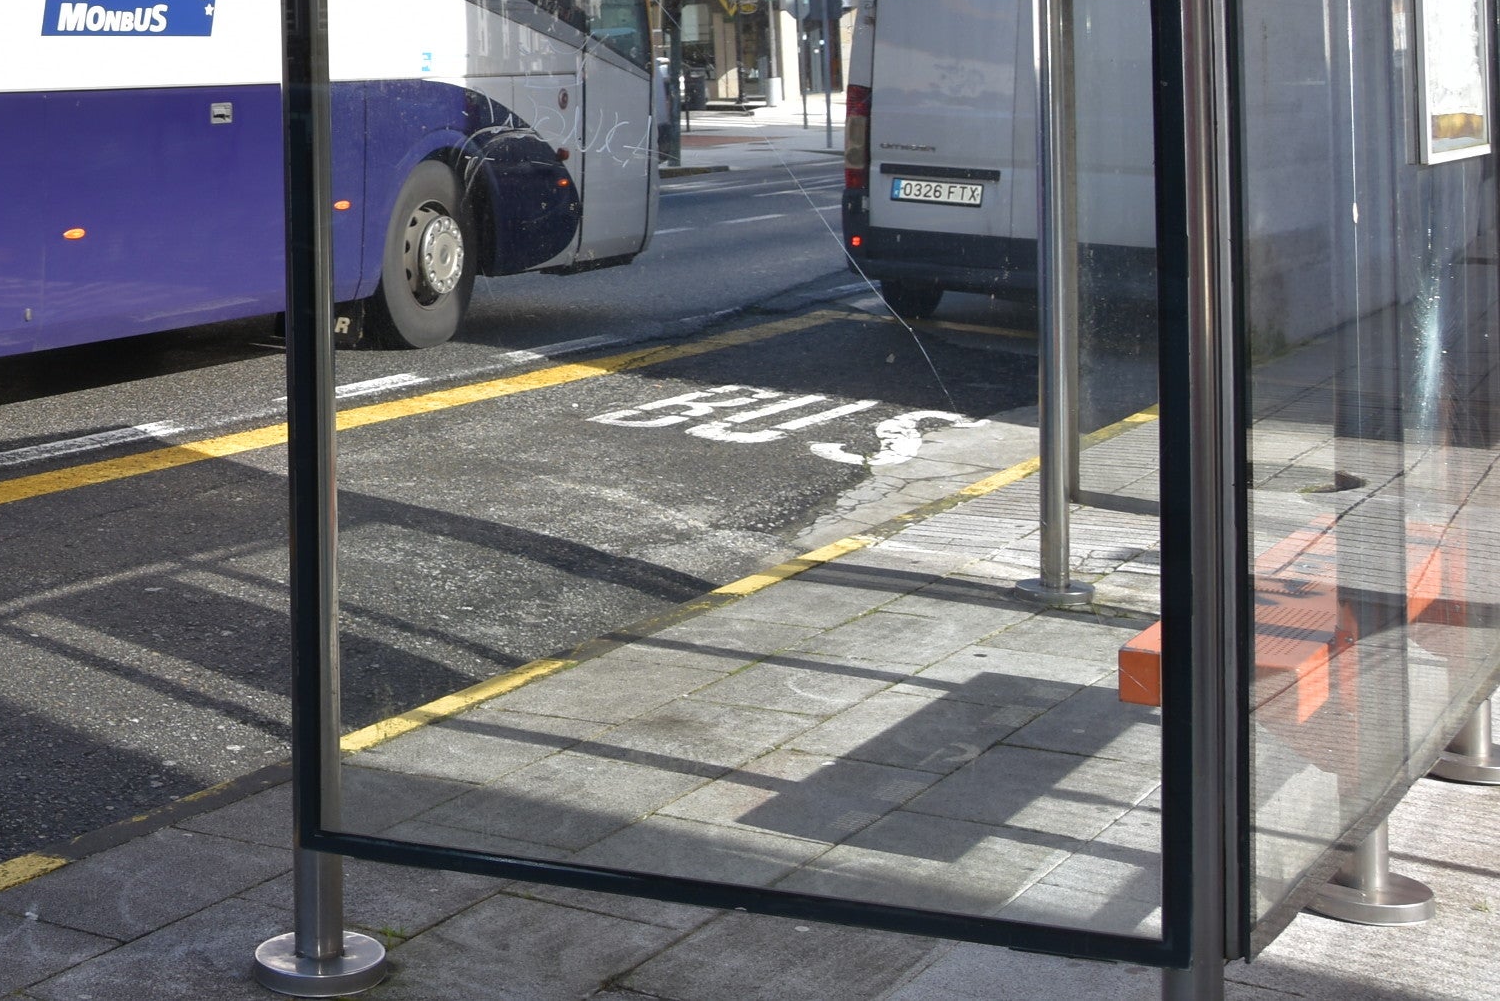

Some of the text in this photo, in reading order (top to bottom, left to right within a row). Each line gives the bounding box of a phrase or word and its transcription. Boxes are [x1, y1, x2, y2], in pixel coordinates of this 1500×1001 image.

[903, 182, 978, 202] 0326 FTX
[584, 384, 991, 466] BUS
